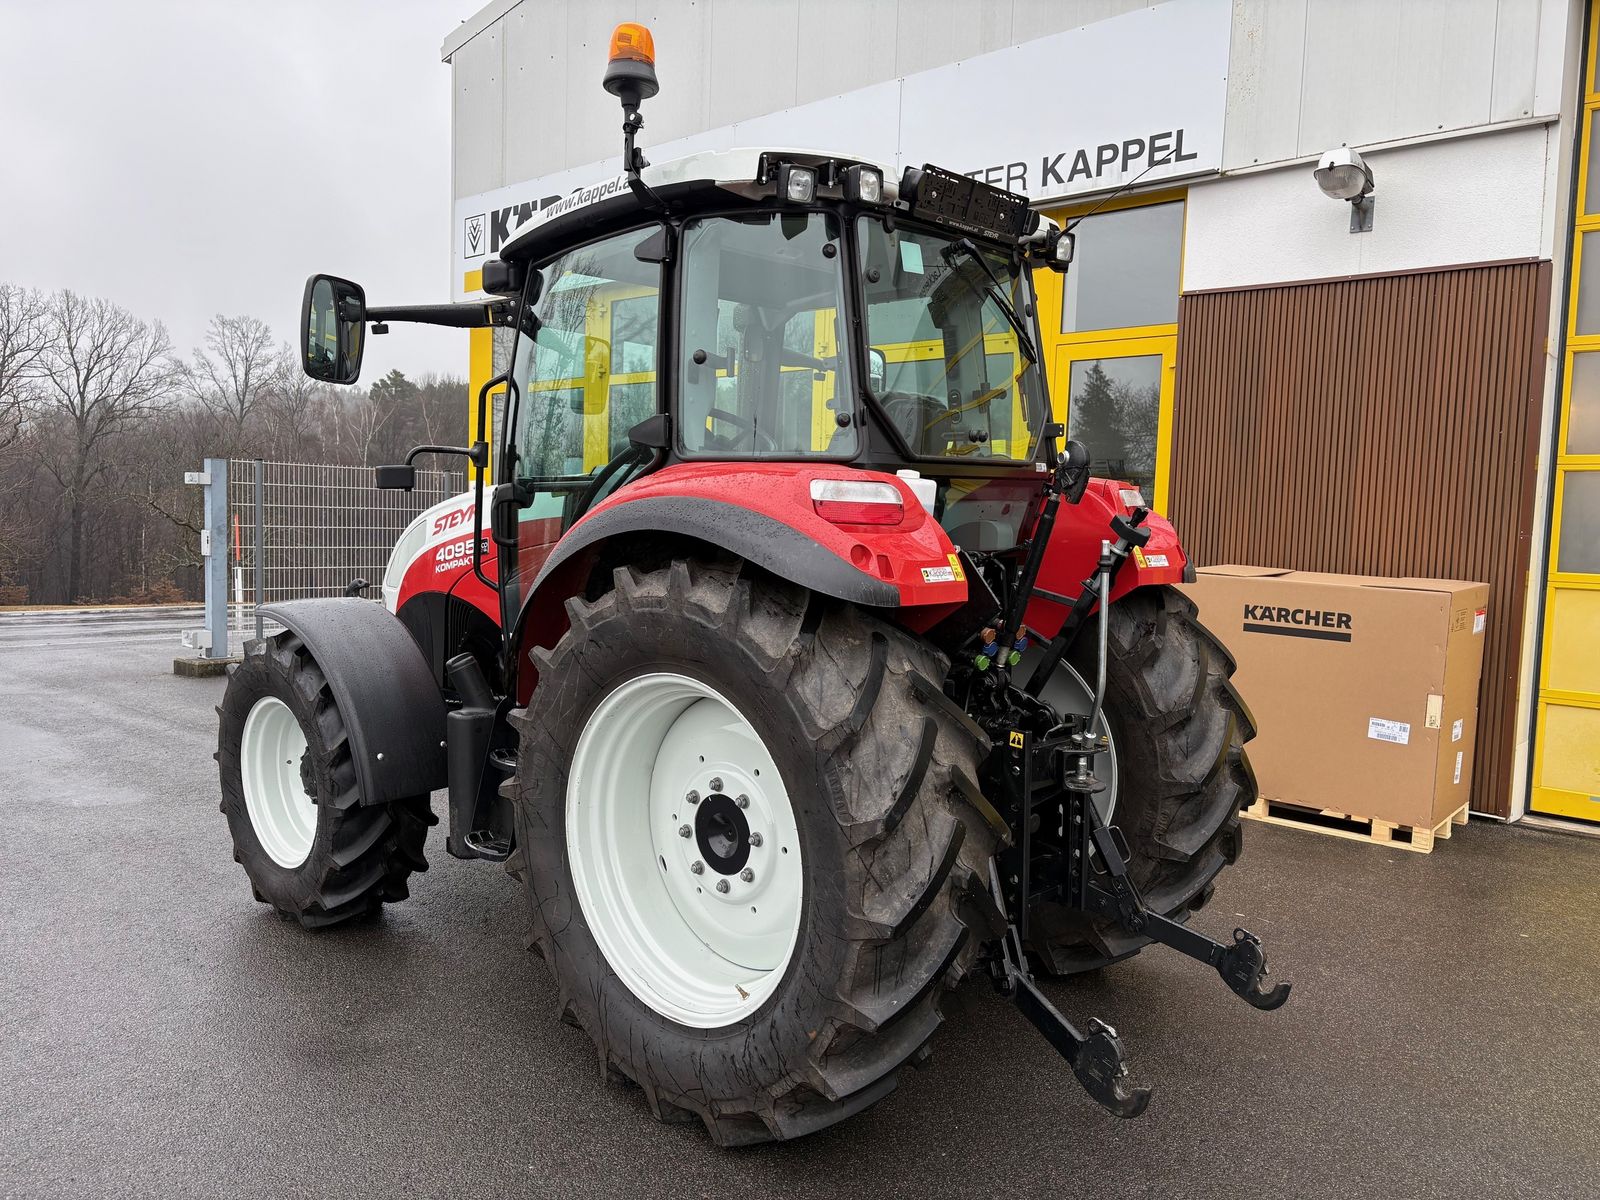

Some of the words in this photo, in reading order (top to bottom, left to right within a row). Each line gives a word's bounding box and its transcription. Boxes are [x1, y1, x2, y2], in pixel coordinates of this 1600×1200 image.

[1042, 129, 1198, 187] KAPPEL
[546, 177, 631, 218] www.kappel.a
[983, 230, 999, 240] STEYR
[436, 538, 474, 561] 4095
[435, 556, 474, 573] KOMPAKT
[1244, 604, 1352, 629] KÄRCHER
